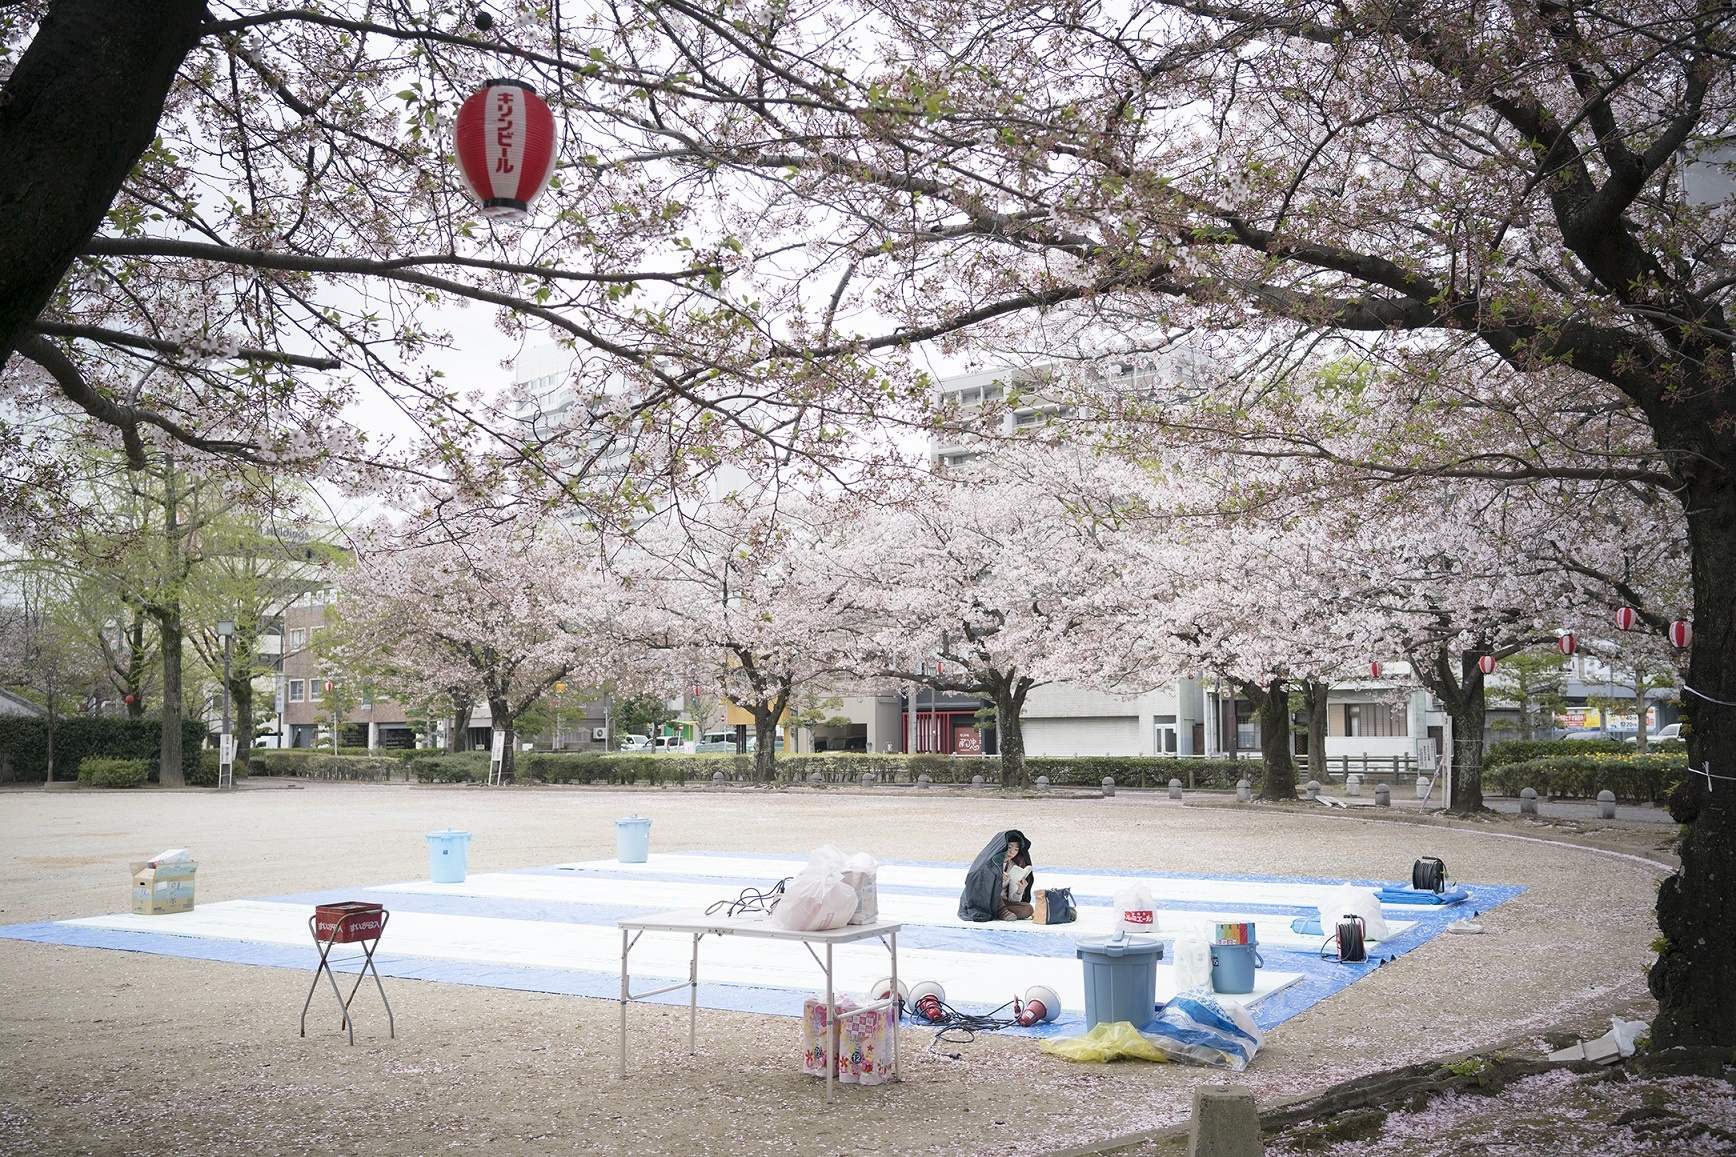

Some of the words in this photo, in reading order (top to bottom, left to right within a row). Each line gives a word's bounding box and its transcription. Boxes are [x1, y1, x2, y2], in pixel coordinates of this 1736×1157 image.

[496, 92, 514, 174] キリンビール
[852, 1054, 861, 1063] 12
